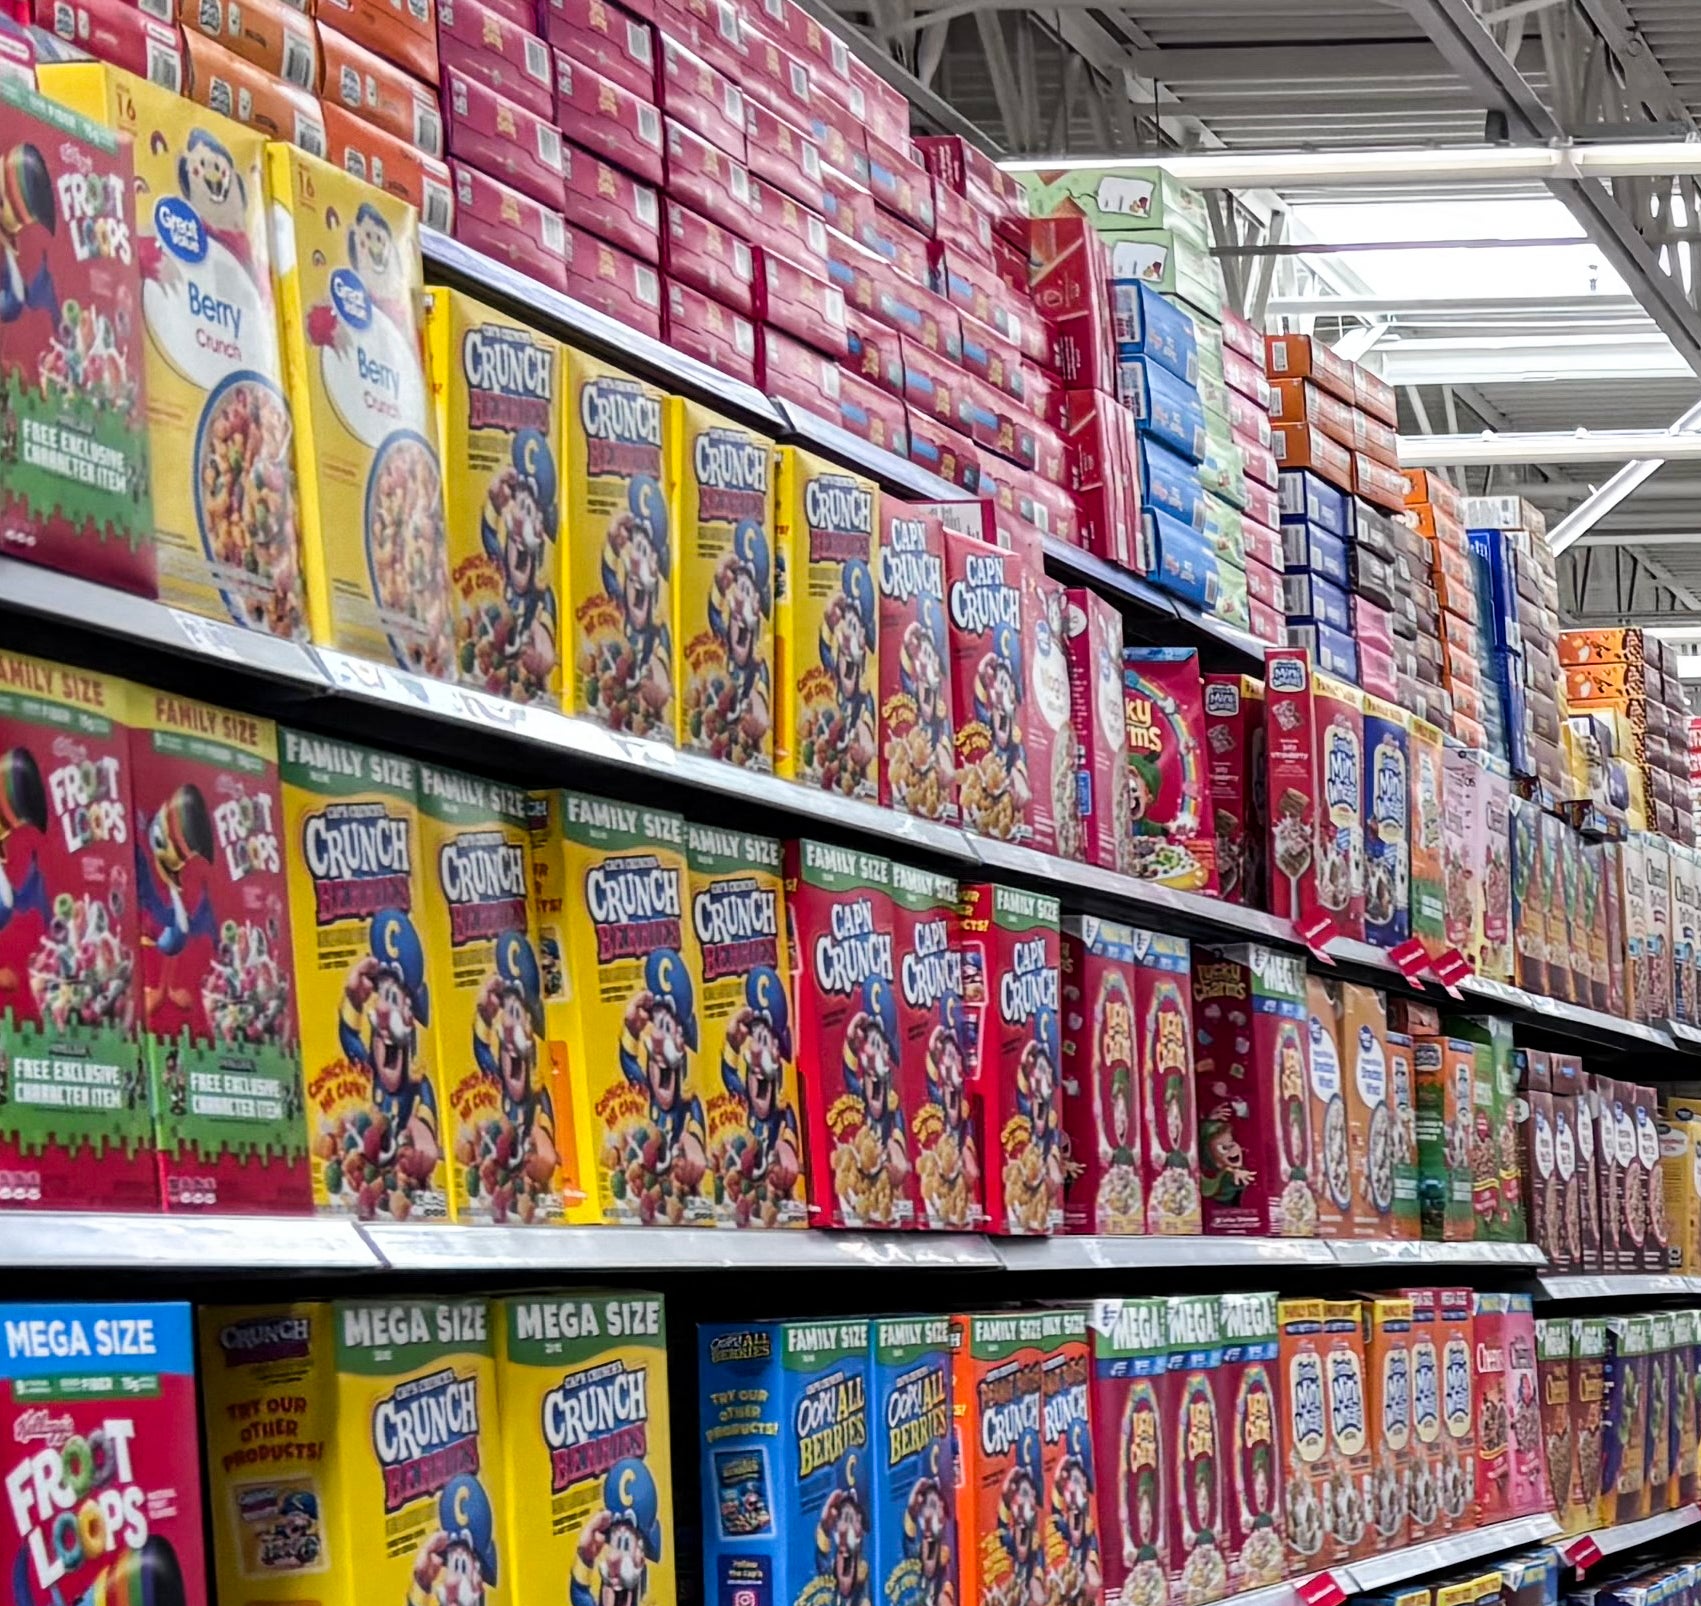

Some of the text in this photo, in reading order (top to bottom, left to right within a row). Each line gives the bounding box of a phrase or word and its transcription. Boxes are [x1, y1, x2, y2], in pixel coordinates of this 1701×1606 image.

[116, 90, 136, 121] 16
[158, 206, 198, 240] Great
[188, 280, 242, 337] Berry
[358, 347, 400, 400] Berry
[464, 330, 551, 399] CRUNCH
[23, 418, 57, 450] FREE
[951, 580, 1021, 634] CRUNCH
[285, 732, 414, 790] FAMILY SIZE
[61, 799, 127, 854] LOOPS
[305, 815, 410, 881] CRUNCH
[225, 830, 280, 882] LOOPS
[441, 843, 524, 903] CRUNCH
[587, 865, 680, 924] CRUNCH
[695, 890, 776, 943] CRUNCH
[815, 931, 892, 994] CRUNCH
[1001, 966, 1058, 1023] CRUNCH
[14, 1057, 120, 1087] FREE EXCLUSIVE
[14, 1083, 121, 1109] CHARACTER ITEM
[4, 1319, 157, 1358] MEGA SIZE
[344, 1304, 487, 1348] MEGA SIZE
[517, 1301, 660, 1341] MEGA SIZE
[788, 1322, 868, 1352] FAMILY SIZE
[880, 1321, 950, 1348] FAMILY SIZE
[226, 1397, 307, 1420] TRY OUR
[241, 1419, 298, 1443] OTHER
[373, 1379, 478, 1463] CRUNCH
[543, 1370, 647, 1448] CRUNCH
[889, 1405, 948, 1466] BERRIES
[799, 1414, 866, 1478] BERRIES
[5, 1418, 135, 1537] FROOT
[28, 1486, 148, 1590] LOOPS
